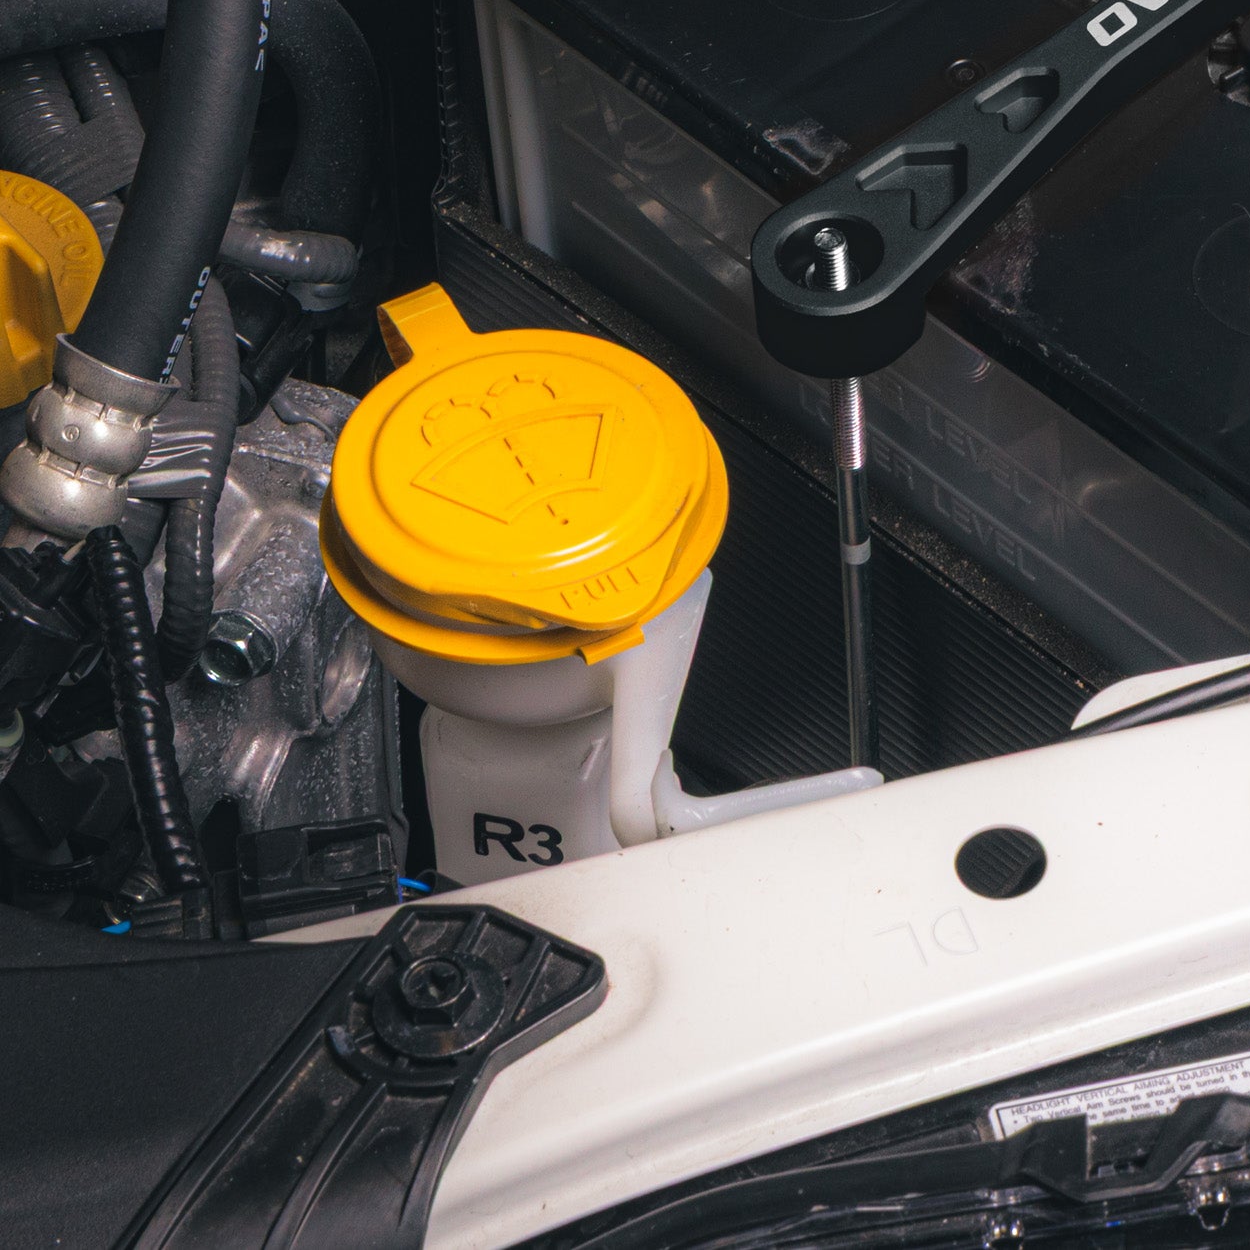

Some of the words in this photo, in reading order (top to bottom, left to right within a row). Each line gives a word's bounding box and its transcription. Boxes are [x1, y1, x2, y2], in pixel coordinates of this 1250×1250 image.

[473, 812, 564, 867] R3
[1010, 1097, 1071, 1117] HEADLIGHT
[1076, 1086, 1128, 1104] VERTICAL
[1133, 1076, 1171, 1092] AIMING
[1175, 1060, 1246, 1083] ADJUSTMENT
[1108, 1092, 1142, 1108] Screws
[1146, 1084, 1176, 1099] should
[1101, 1106, 1127, 1119] same
